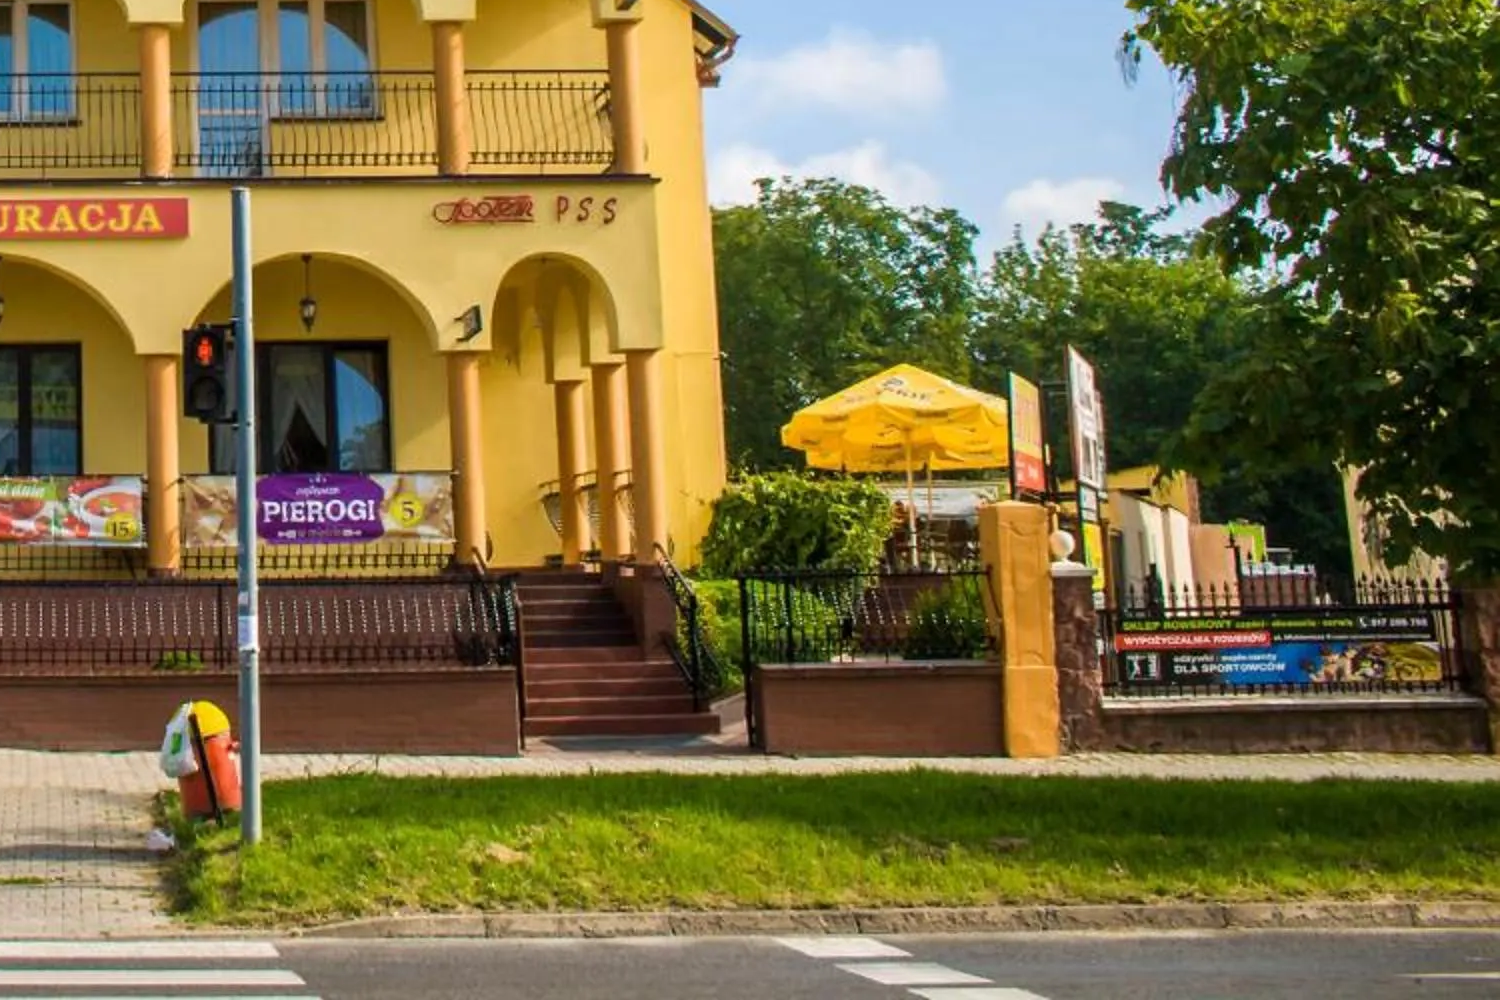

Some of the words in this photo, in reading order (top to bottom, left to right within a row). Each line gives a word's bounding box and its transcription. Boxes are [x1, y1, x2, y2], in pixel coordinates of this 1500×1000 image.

[262, 499, 375, 523] PIEROGI
[401, 500, 416, 522] 5
[111, 521, 131, 537] 15
[1173, 664, 1200, 674] DLA
[1201, 661, 1287, 673] SPORTOWCÓW
